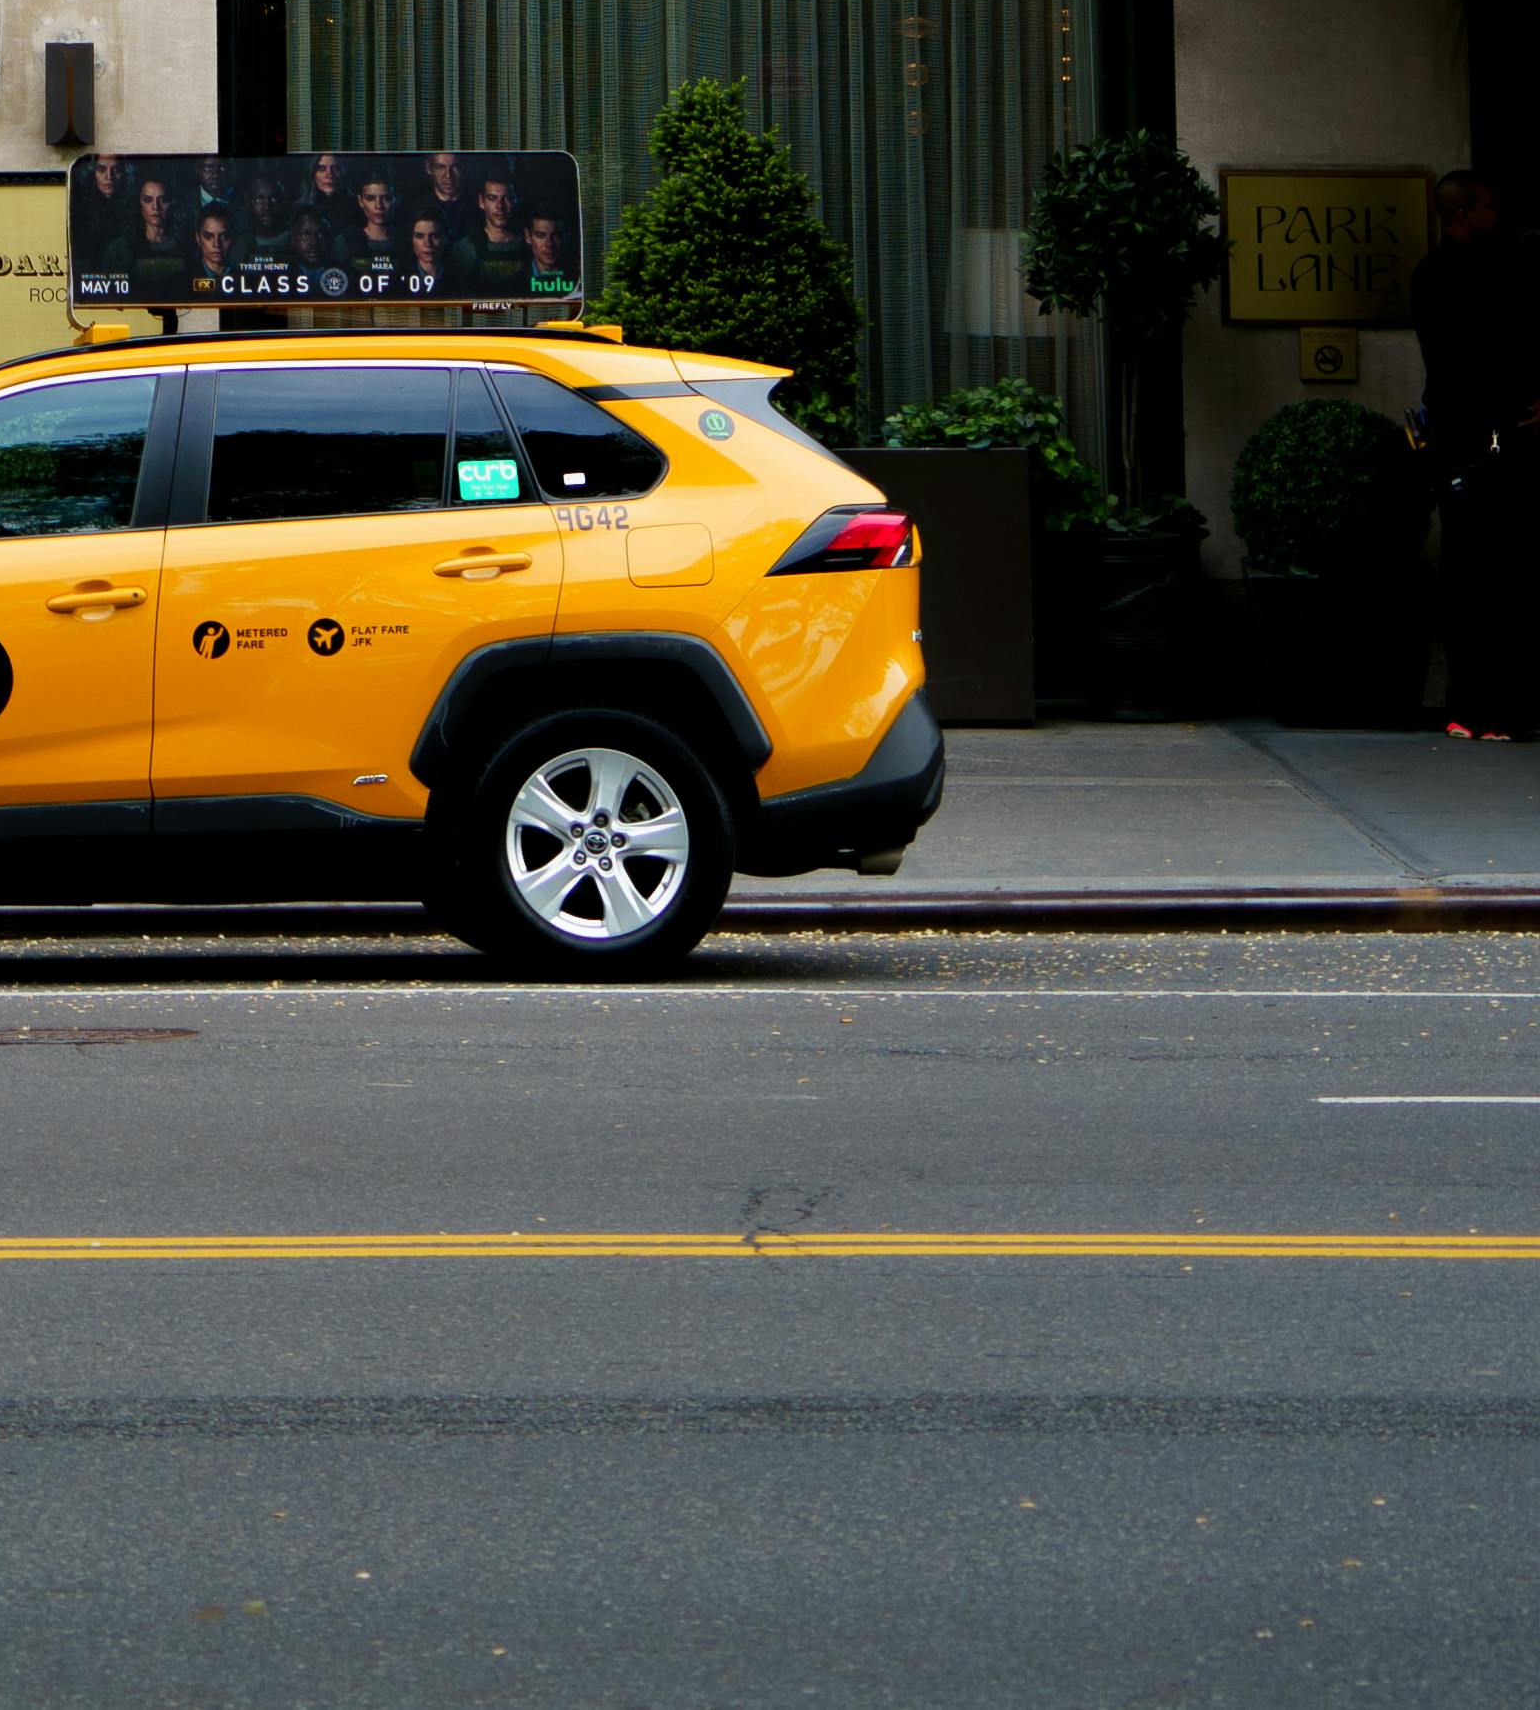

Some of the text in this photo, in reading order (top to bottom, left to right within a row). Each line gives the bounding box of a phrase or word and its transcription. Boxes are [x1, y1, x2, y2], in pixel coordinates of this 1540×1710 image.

[1256, 206, 1398, 245] PARK
[263, 263, 290, 271] HENRY
[1258, 254, 1400, 292] LANE
[81, 280, 129, 294] MAY 10
[221, 275, 310, 293] CLASS
[359, 275, 390, 293] OF
[530, 277, 574, 292] hulu
[472, 302, 513, 310] FIREFLY
[459, 461, 517, 482] curb
[556, 505, 630, 532] 9G42
[236, 628, 288, 639] METERED
[351, 625, 410, 635] FLAT FARE
[236, 640, 265, 650] FARE
[351, 638, 372, 647] JFK
